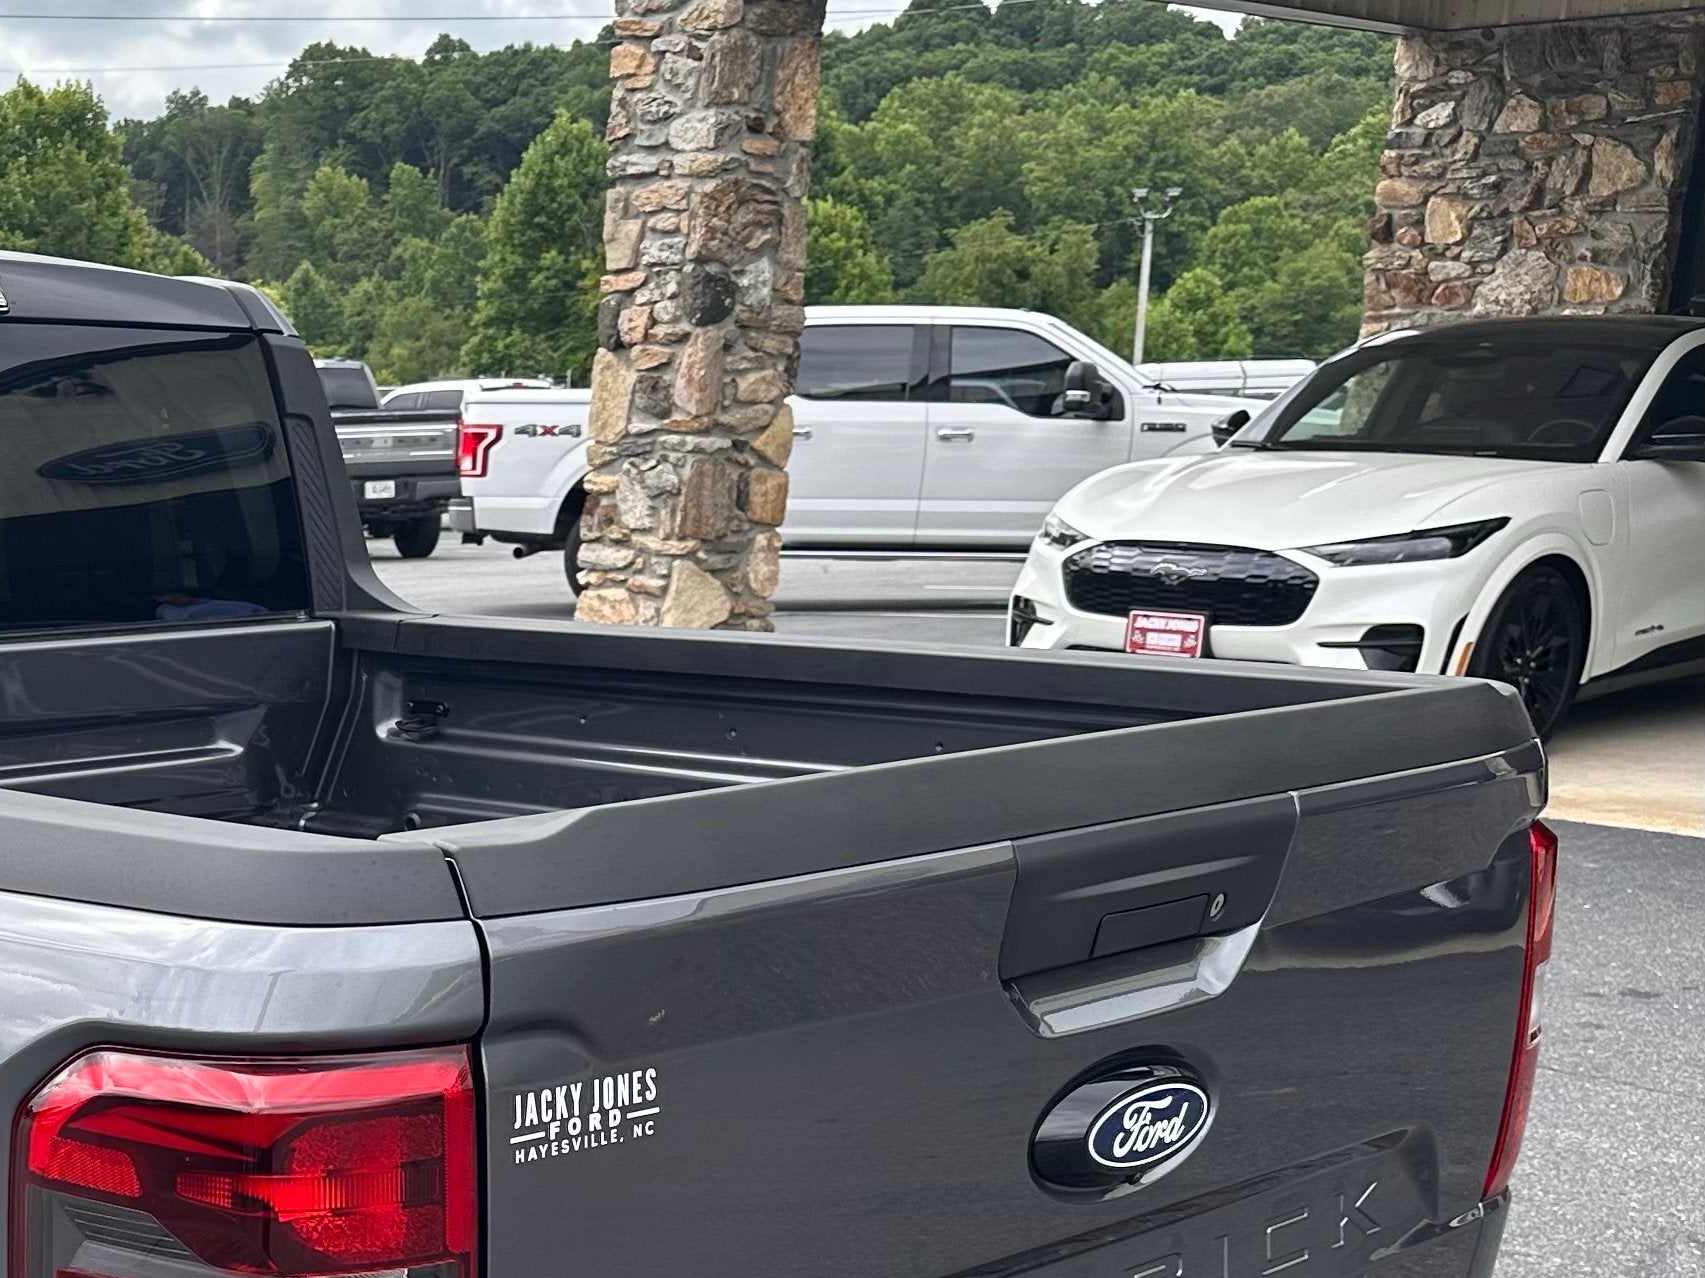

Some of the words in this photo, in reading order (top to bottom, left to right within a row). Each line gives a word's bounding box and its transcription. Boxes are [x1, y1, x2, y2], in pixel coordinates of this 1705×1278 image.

[514, 1082, 582, 1130] JACKY
[592, 1067, 657, 1113] JONES
[549, 1108, 622, 1140] FORD
[515, 1128, 624, 1164] HAYESVILLE,
[633, 1120, 655, 1138] NC
[1113, 1095, 1189, 1158] Ford
